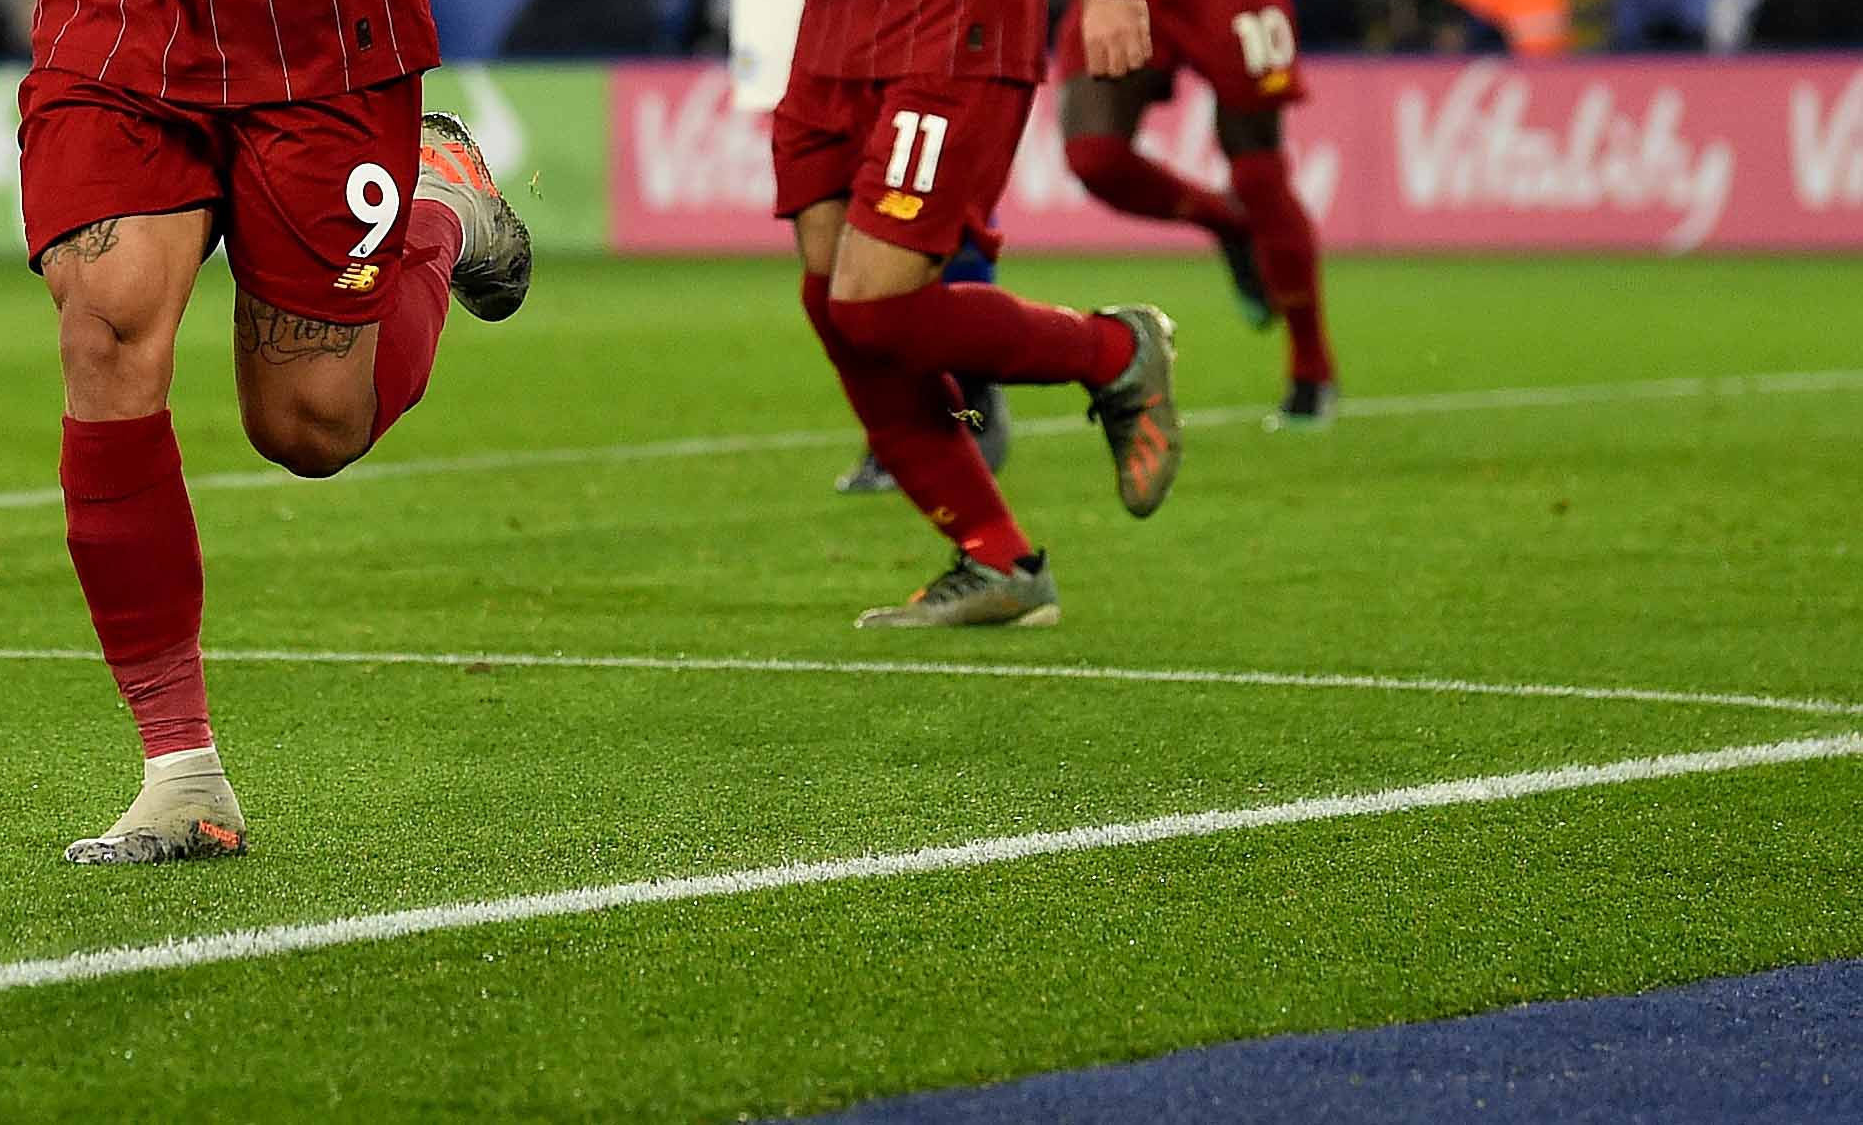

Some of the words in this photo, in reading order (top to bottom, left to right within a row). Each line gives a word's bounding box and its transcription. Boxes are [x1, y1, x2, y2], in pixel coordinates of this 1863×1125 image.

[1232, 5, 1296, 76] 10
[885, 110, 948, 192] 11
[1394, 57, 1736, 256] Vitality
[346, 163, 400, 258] 9
